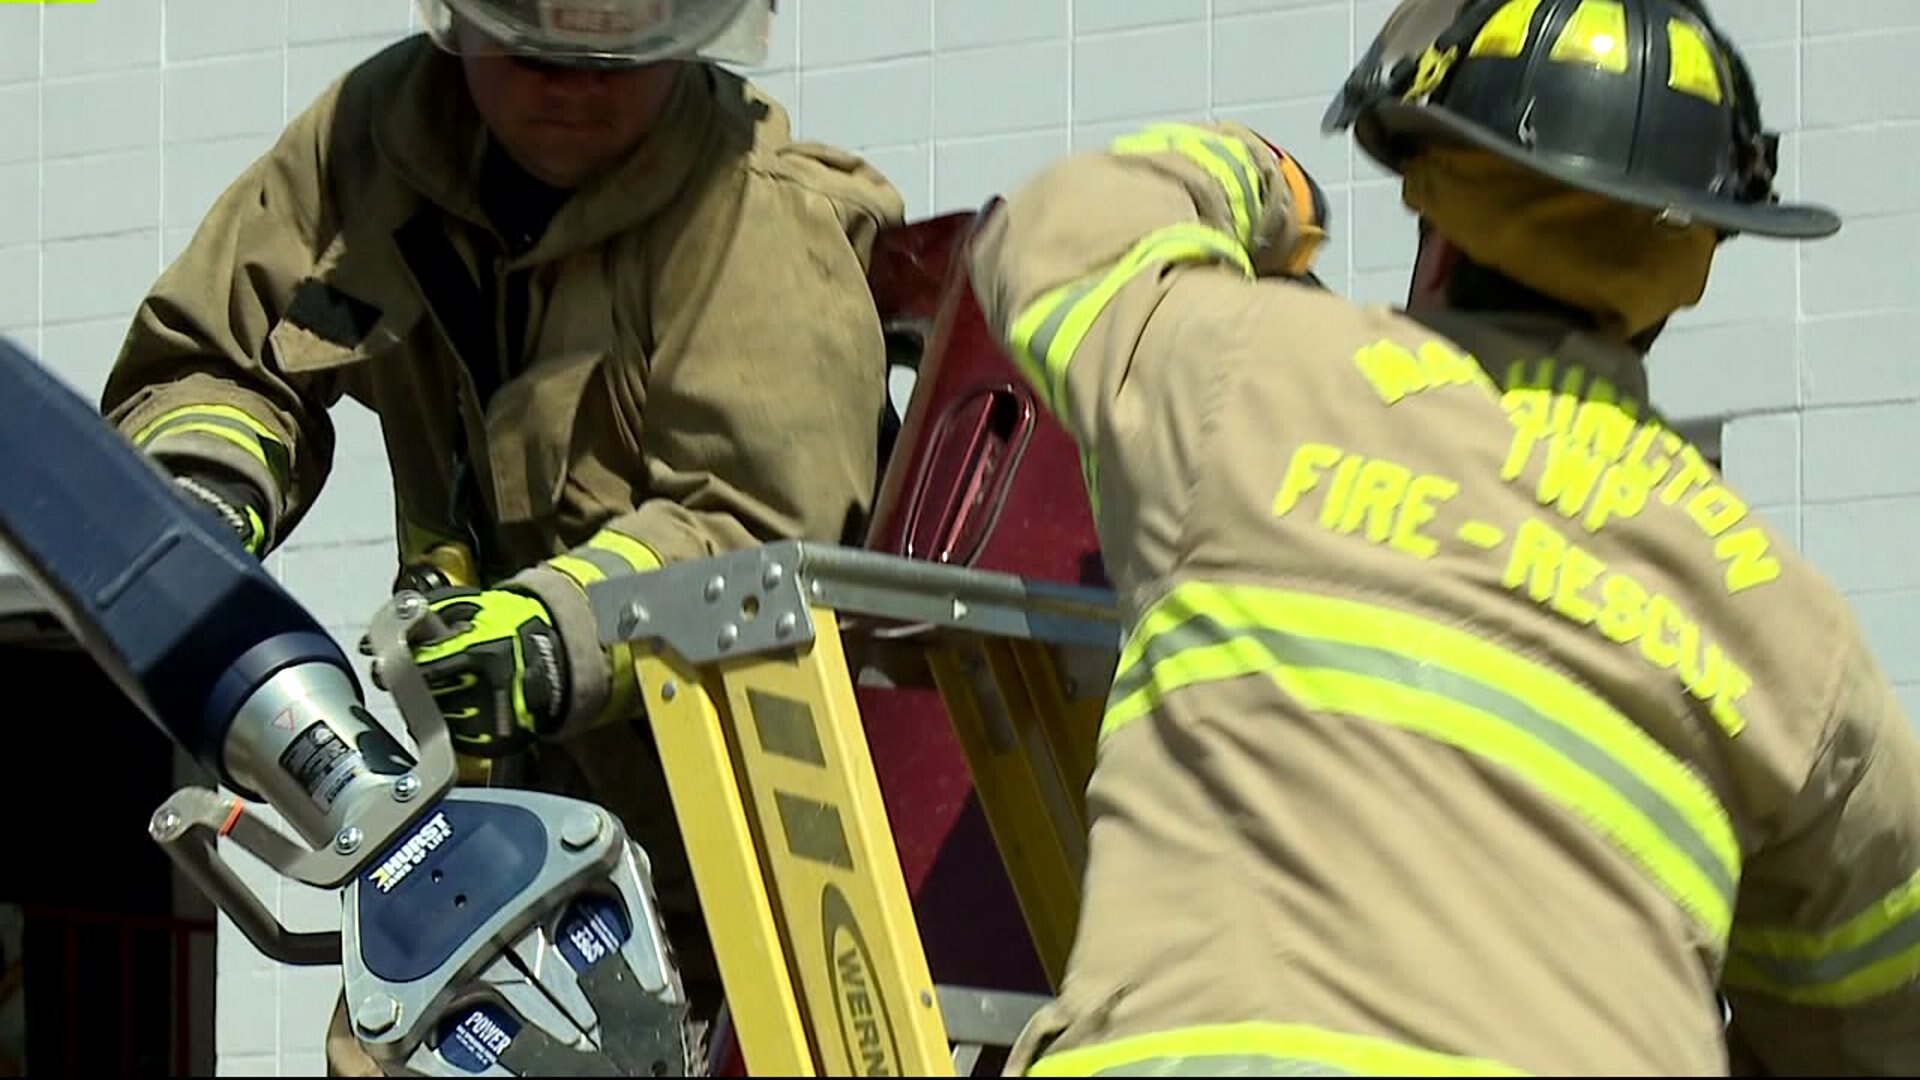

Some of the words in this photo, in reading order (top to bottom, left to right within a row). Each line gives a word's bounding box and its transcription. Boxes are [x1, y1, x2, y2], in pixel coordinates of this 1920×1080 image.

[1501, 392, 1649, 533] TWP
[1273, 443, 1458, 559] FIRE
[1503, 517, 1753, 738] RESCUE
[381, 811, 450, 878] HURST
[383, 862, 413, 893] JAWS
[411, 848, 426, 864] OF
[426, 827, 452, 850] LIFE
[465, 1011, 512, 1056] POWER
